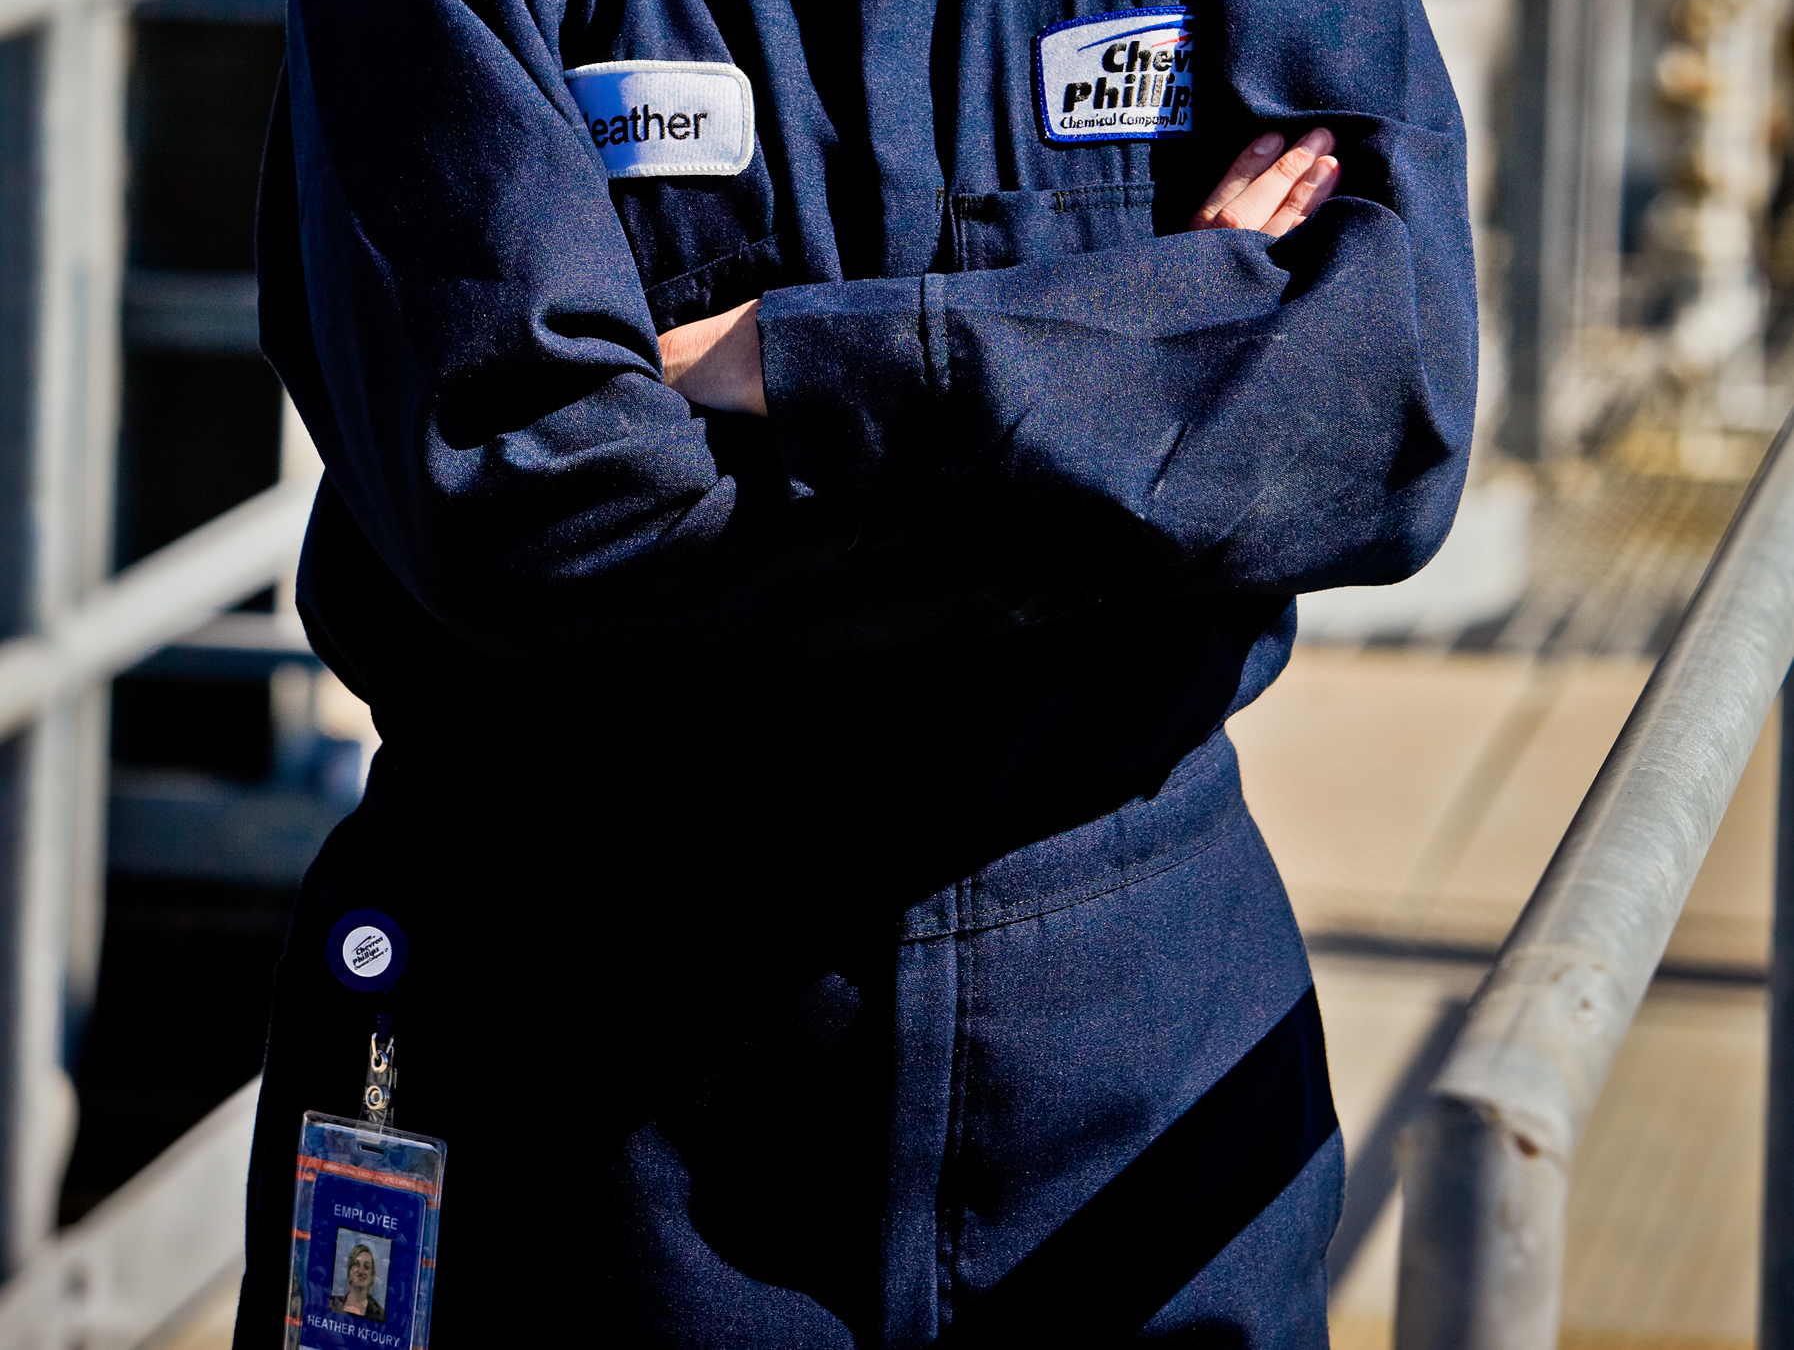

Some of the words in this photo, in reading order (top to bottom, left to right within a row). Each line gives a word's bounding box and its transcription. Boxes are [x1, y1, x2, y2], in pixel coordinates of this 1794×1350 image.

[1102, 40, 1191, 73] Chev
[1062, 73, 1193, 125] Phillip
[584, 104, 708, 148] eather
[1060, 112, 1117, 129] Chemical
[352, 947, 380, 966] Phillips
[356, 936, 383, 955] Chevron
[334, 1204, 399, 1230] EMPLOYEE
[307, 1315, 356, 1337] HEATHER
[357, 1327, 400, 1347] KFOURY
